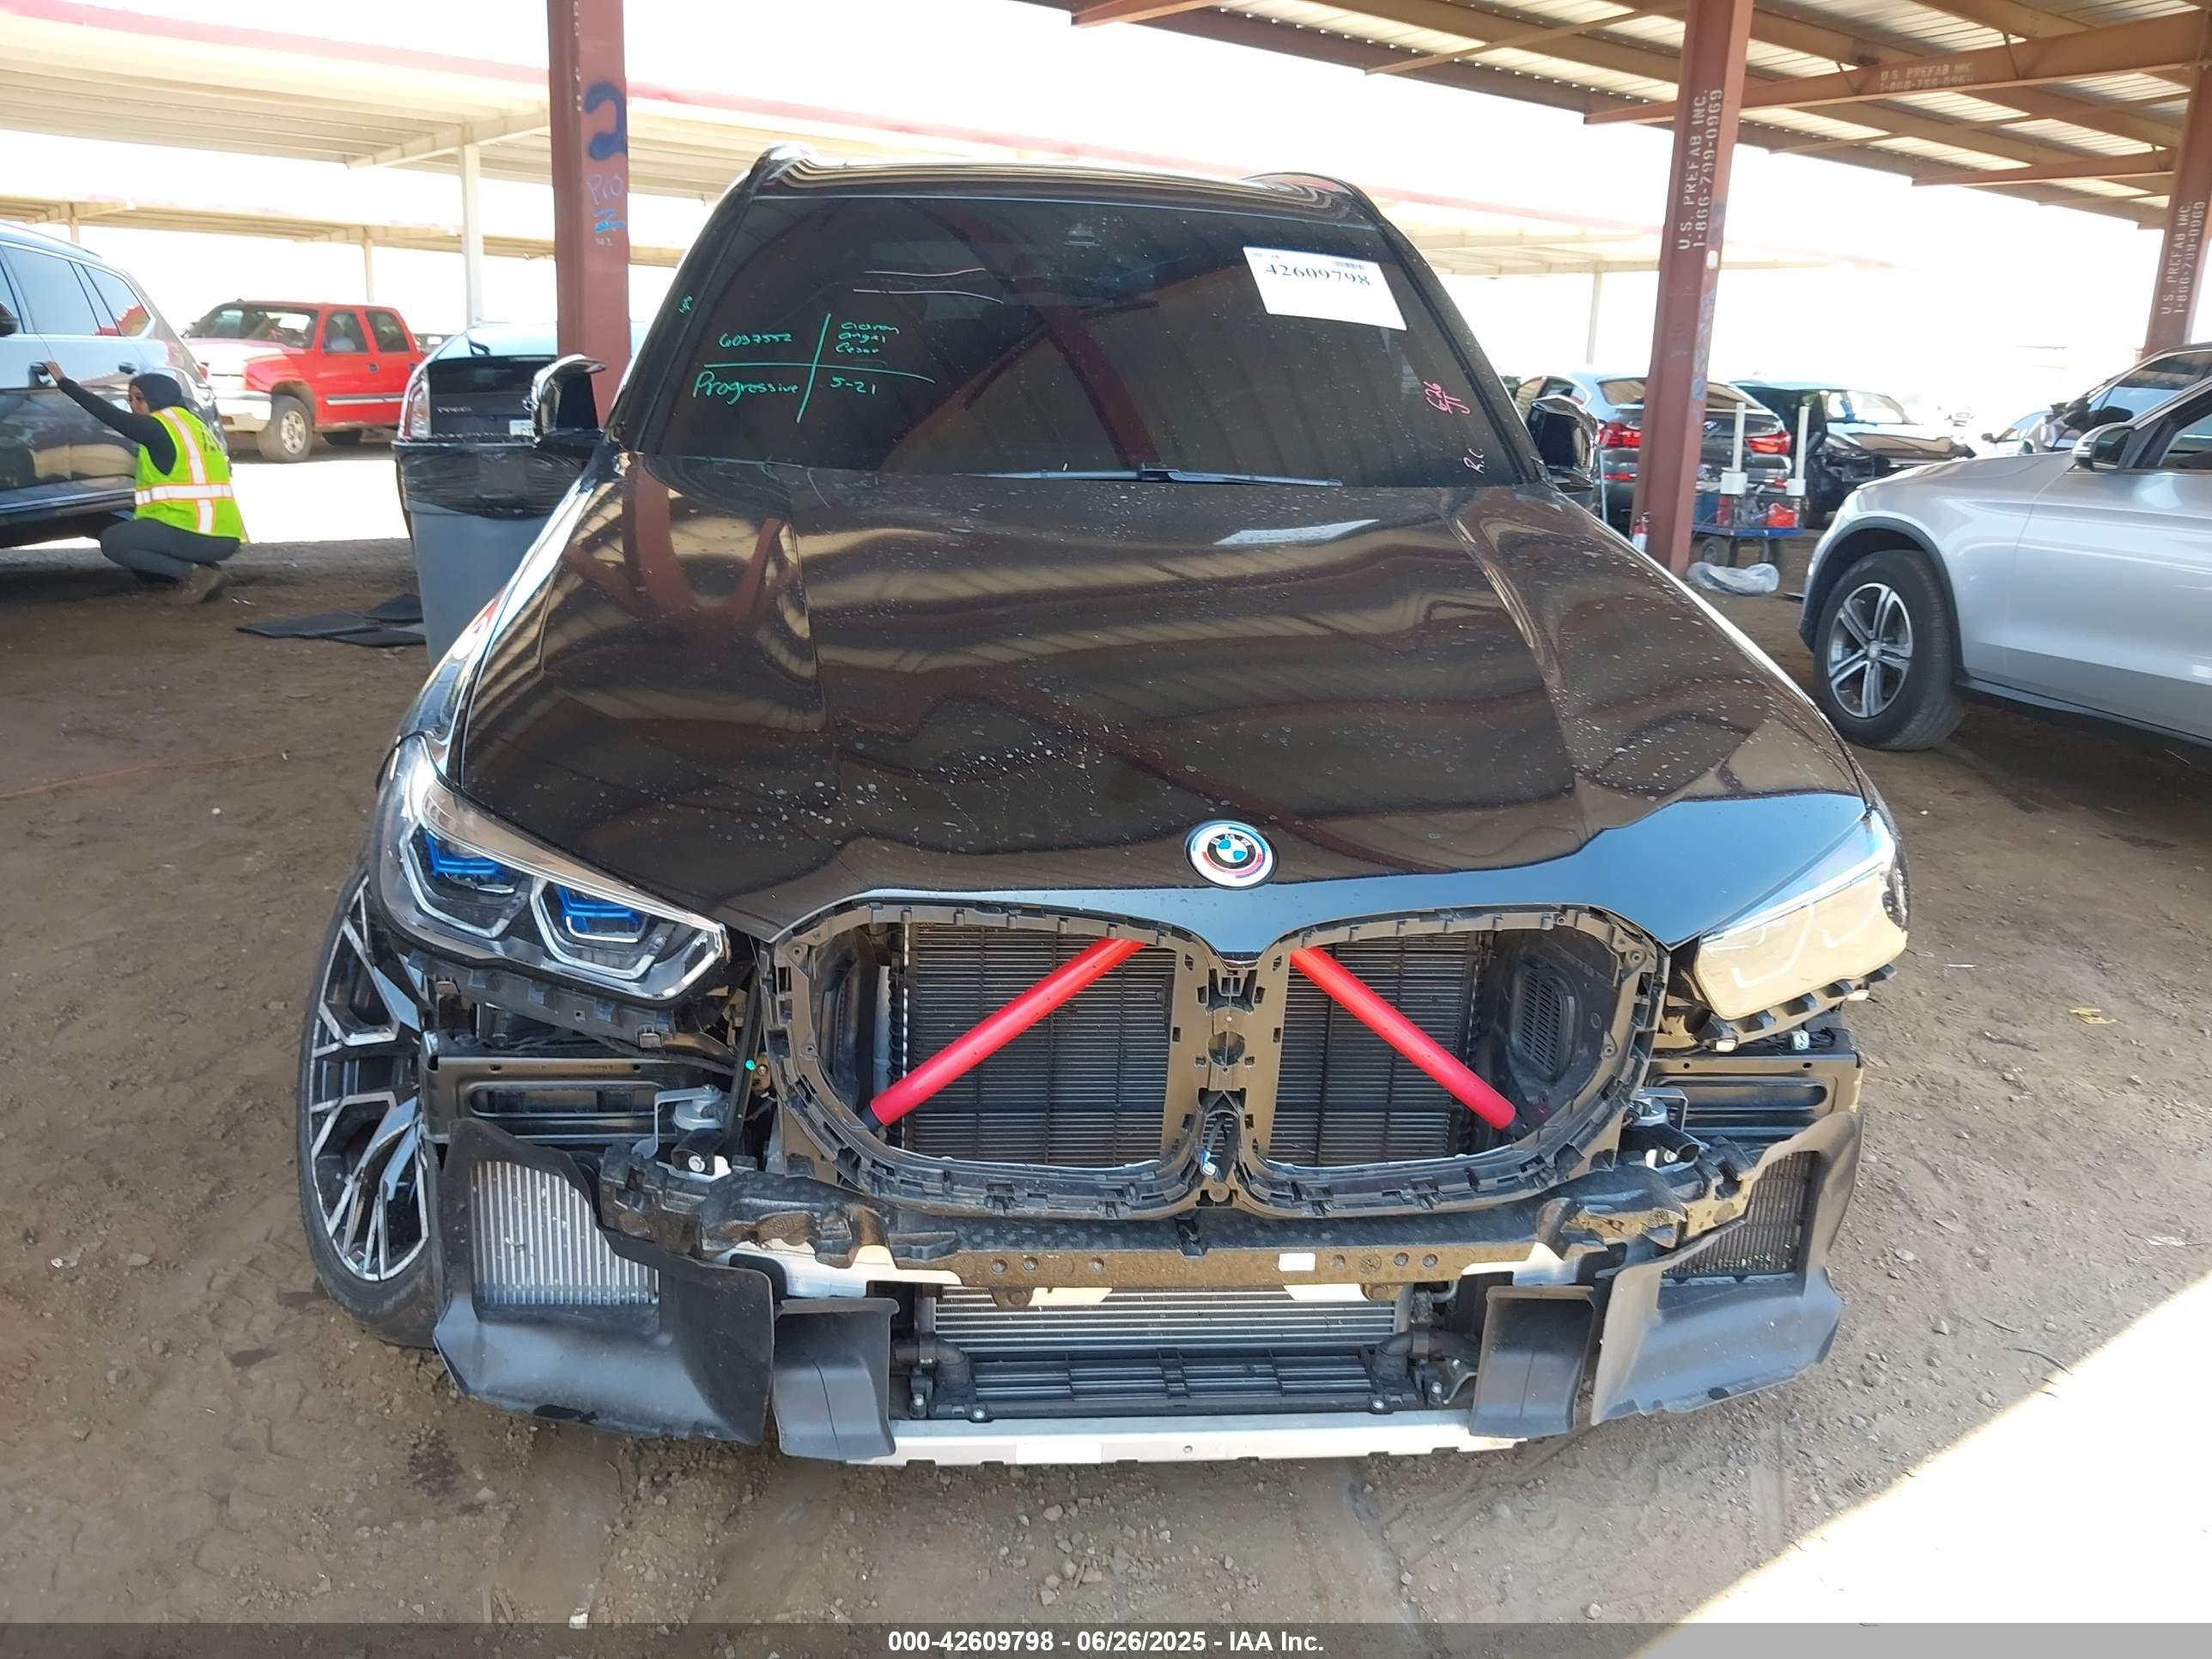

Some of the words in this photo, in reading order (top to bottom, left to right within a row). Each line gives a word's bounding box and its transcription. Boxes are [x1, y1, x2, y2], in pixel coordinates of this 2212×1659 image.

[583, 82, 628, 161] 2
[1692, 89, 1708, 125] INC.
[1683, 134, 1702, 205] PREFAB
[1692, 89, 1723, 247] 1-866-799-0969
[1678, 216, 1693, 250] U.S.
[1266, 264, 1371, 286] 42609798
[2166, 233, 2186, 283] PREFAB
[692, 370, 799, 405] Progressive
[830, 377, 876, 395] 5-21
